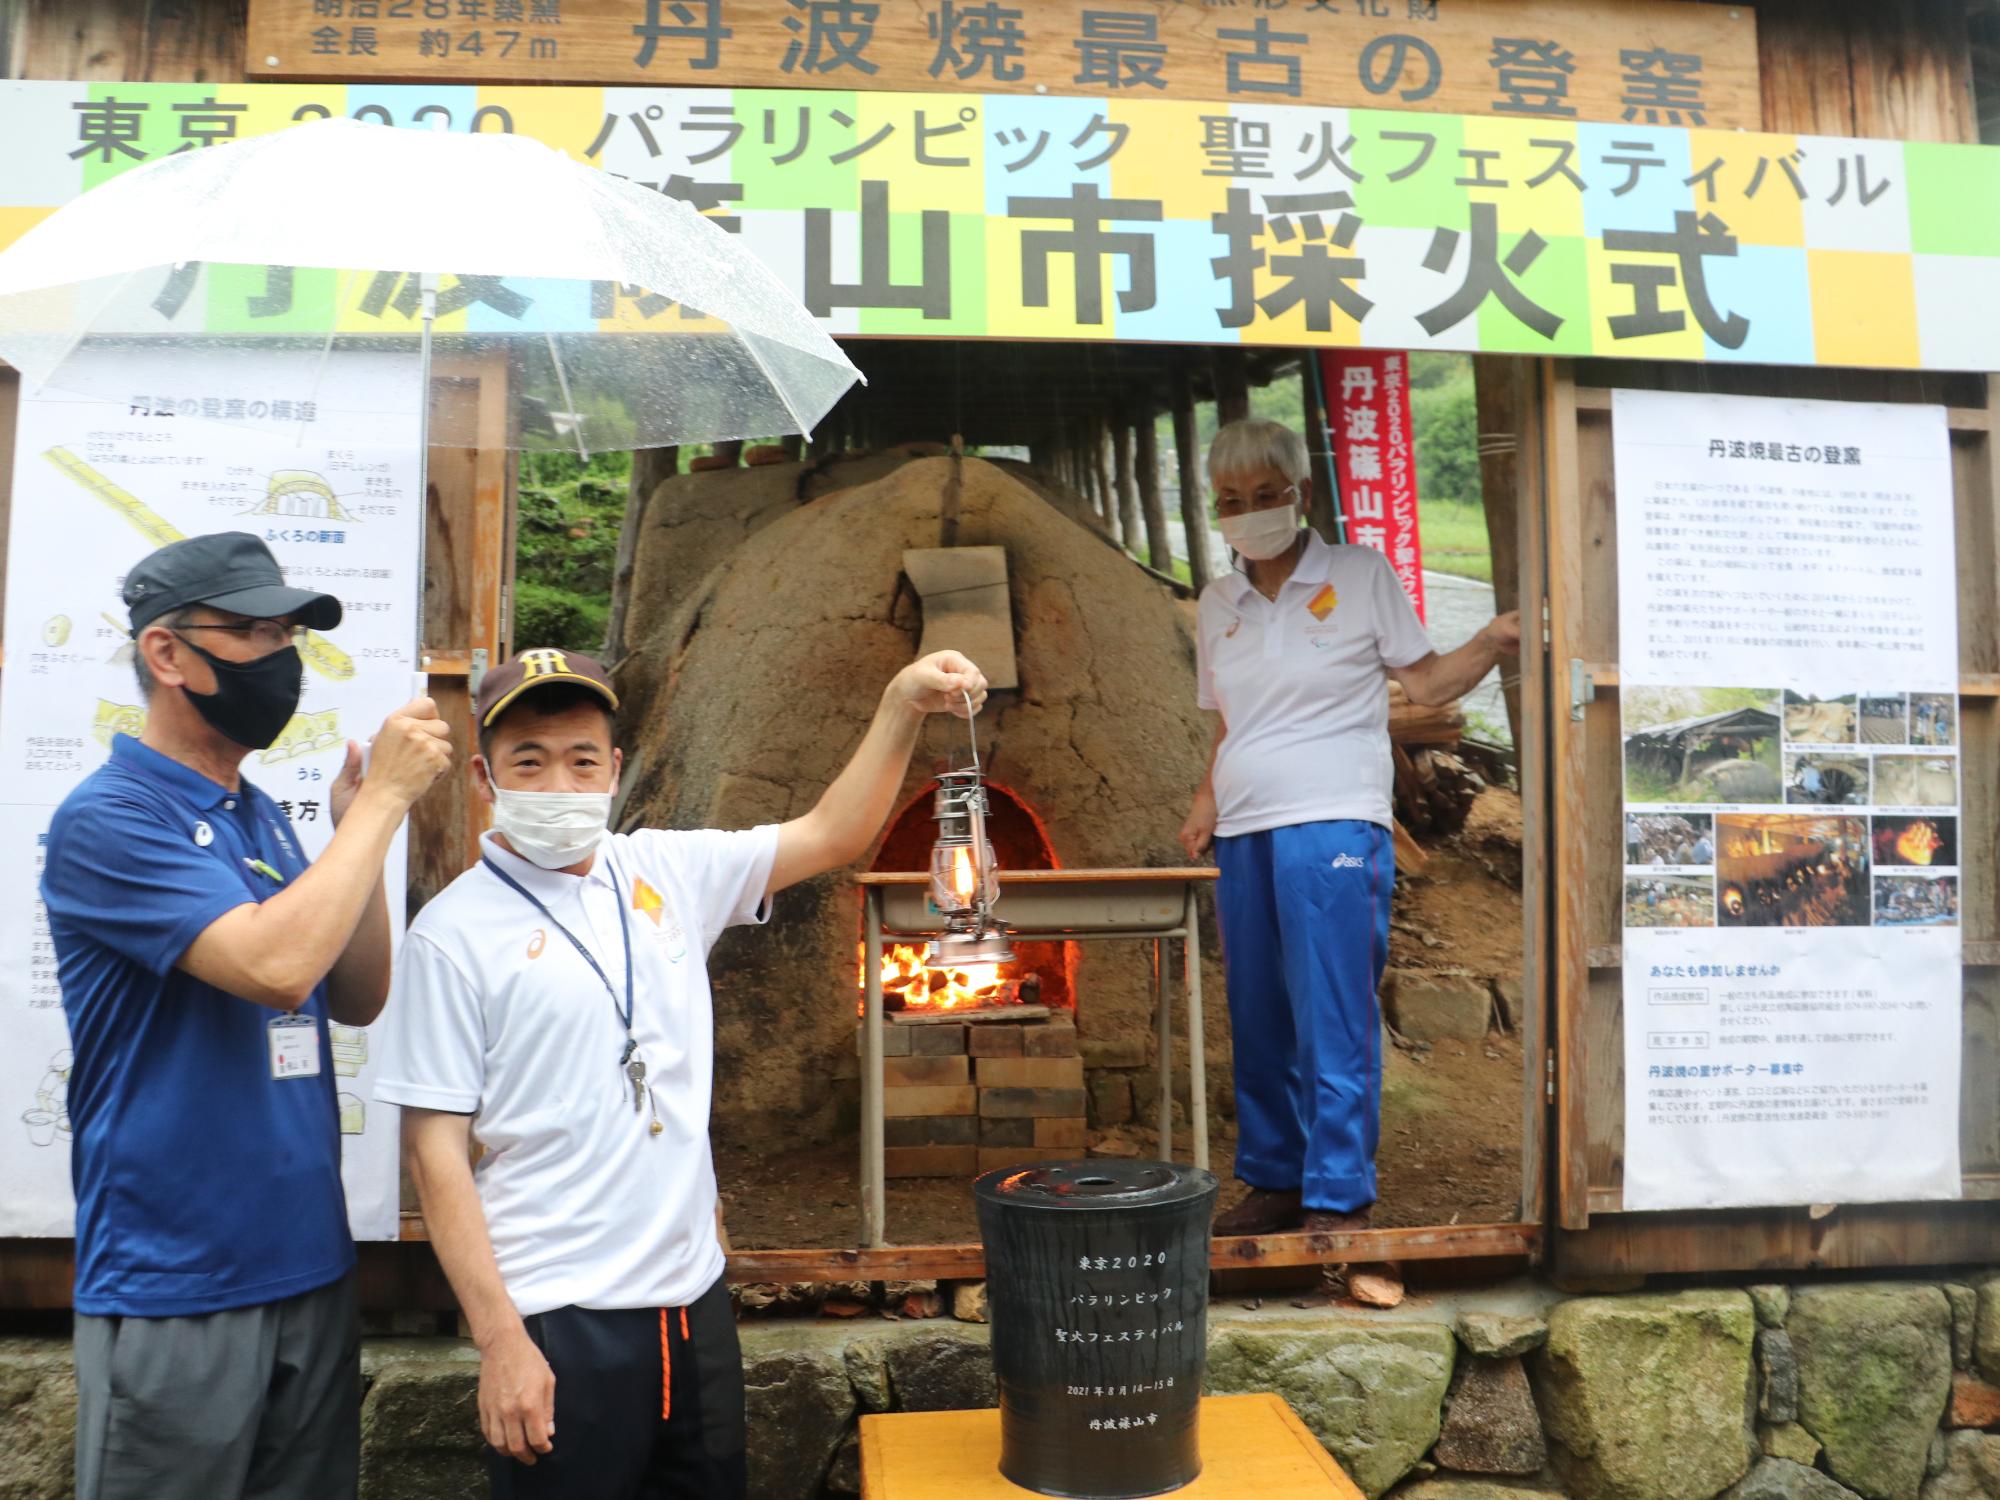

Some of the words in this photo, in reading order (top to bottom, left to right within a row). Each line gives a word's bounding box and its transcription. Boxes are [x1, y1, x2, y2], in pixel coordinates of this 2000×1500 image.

[311, 26, 379, 56] 全長
[633, 0, 1706, 126] 丹波焼最古の登窯
[583, 104, 1131, 174] パラリンピック
[1200, 114, 1891, 208] 聖火フェスティバル
[1708, 438, 1862, 466] 丹波焼最古の登窯
[298, 767, 322, 781] うら
[1079, 1251, 1167, 1271] 東京2020
[1069, 1287, 1173, 1307] パラリンピック
[1054, 1320, 1185, 1344] 聖火フェスティバル
